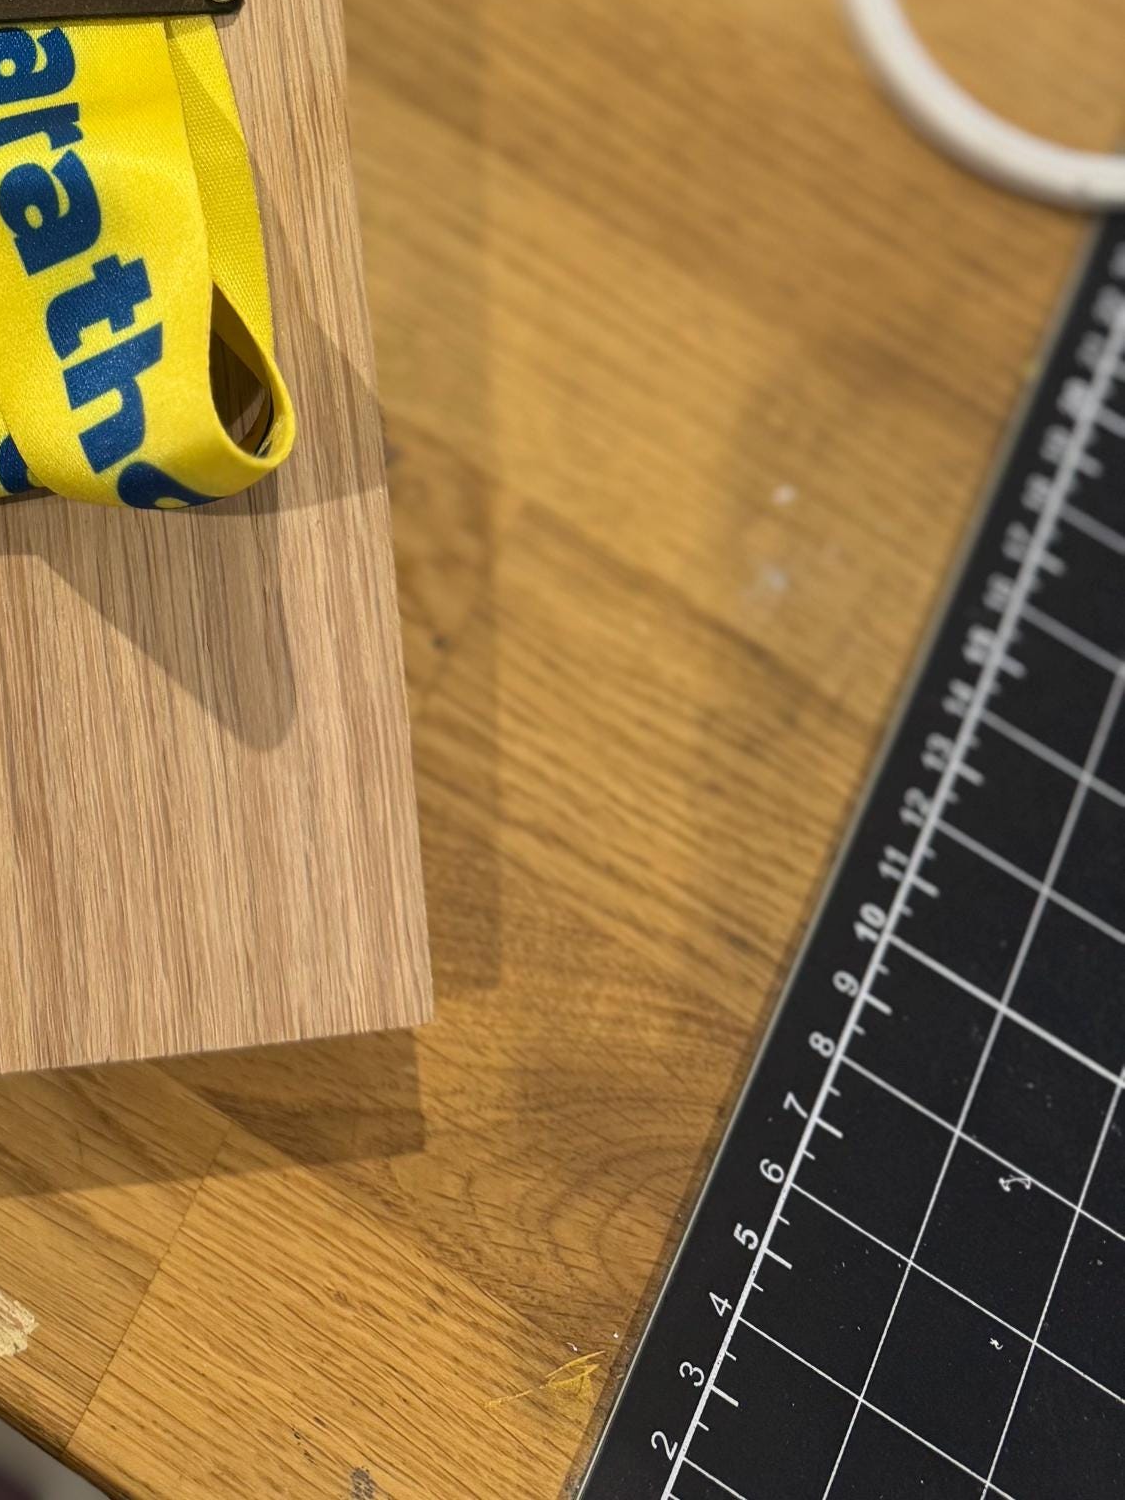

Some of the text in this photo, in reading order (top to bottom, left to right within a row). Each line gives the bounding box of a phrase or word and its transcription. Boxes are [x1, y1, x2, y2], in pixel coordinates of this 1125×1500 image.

[650, 1430, 678, 1460] 2
[679, 1361, 705, 1387] 3
[709, 1292, 732, 1317] 4
[733, 1223, 759, 1250] 5
[759, 1158, 785, 1184] 6
[783, 1091, 808, 1119] 7
[808, 1031, 835, 1058] 8
[832, 970, 860, 997] 9
[853, 903, 887, 943] 10
[878, 845, 909, 878] 11
[899, 786, 933, 827] 12
[921, 732, 955, 771] 13
